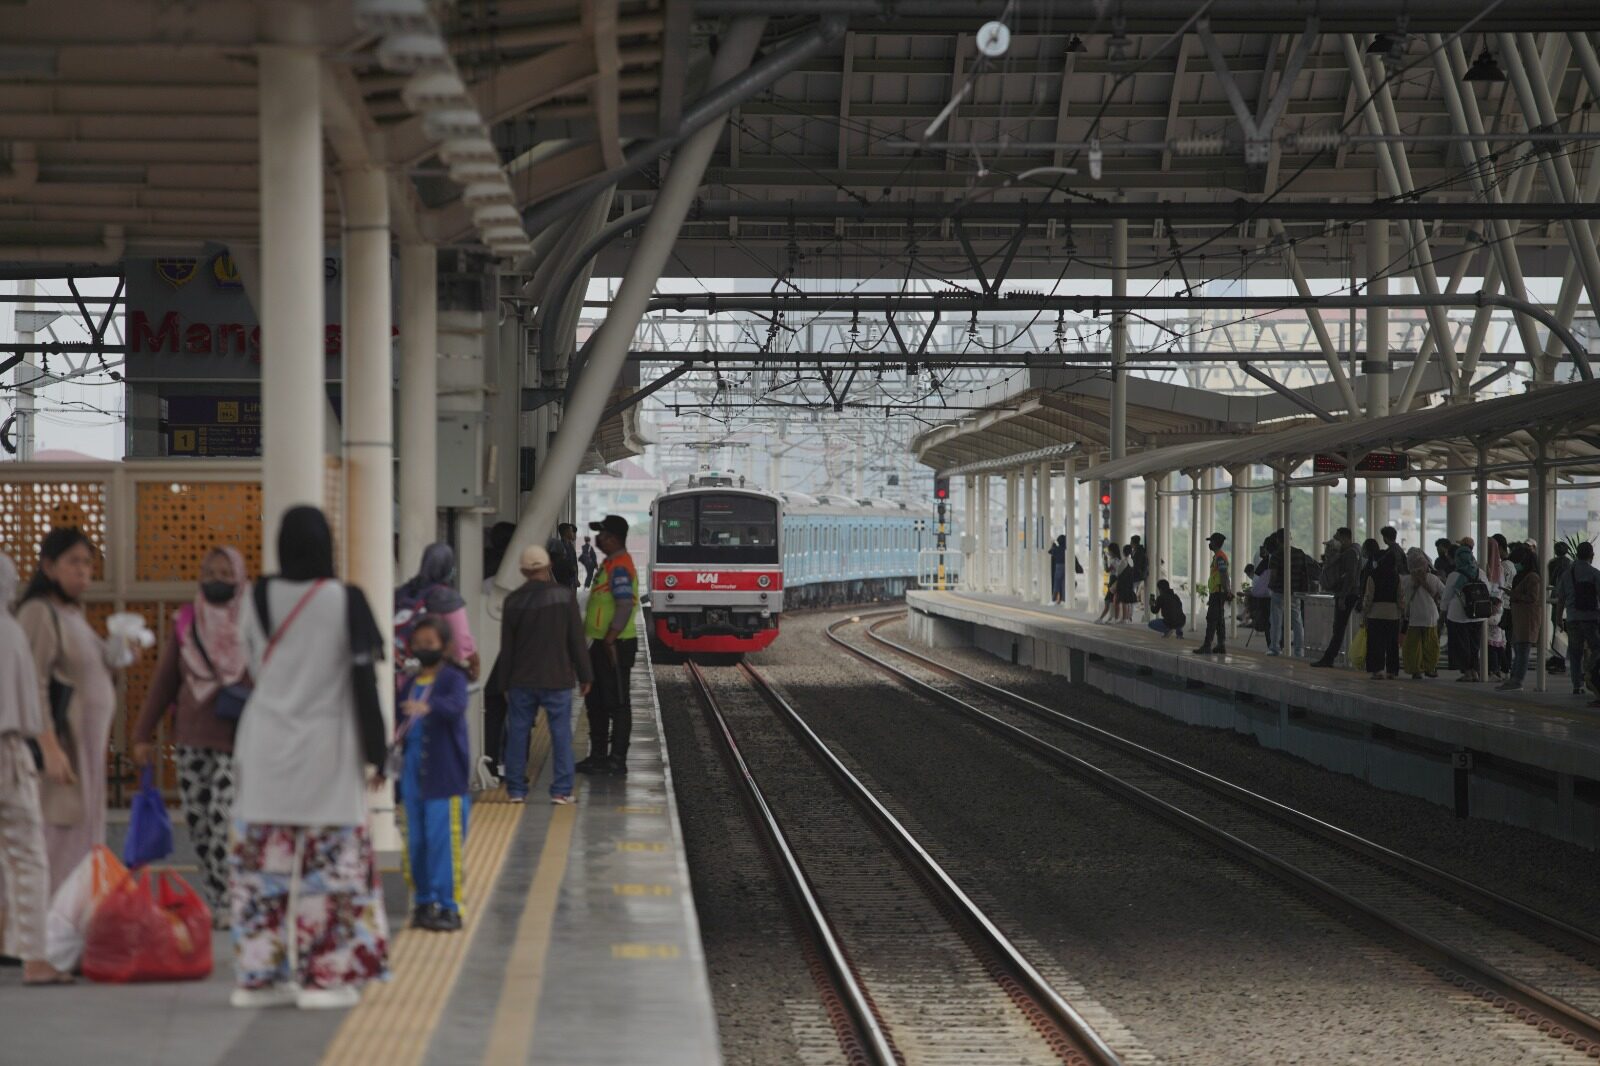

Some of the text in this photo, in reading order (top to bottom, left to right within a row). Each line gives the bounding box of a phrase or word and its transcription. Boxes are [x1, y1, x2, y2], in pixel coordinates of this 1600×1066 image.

[181, 434, 188, 447] 1
[696, 573, 719, 584] KAI
[1458, 754, 1468, 767] 9
